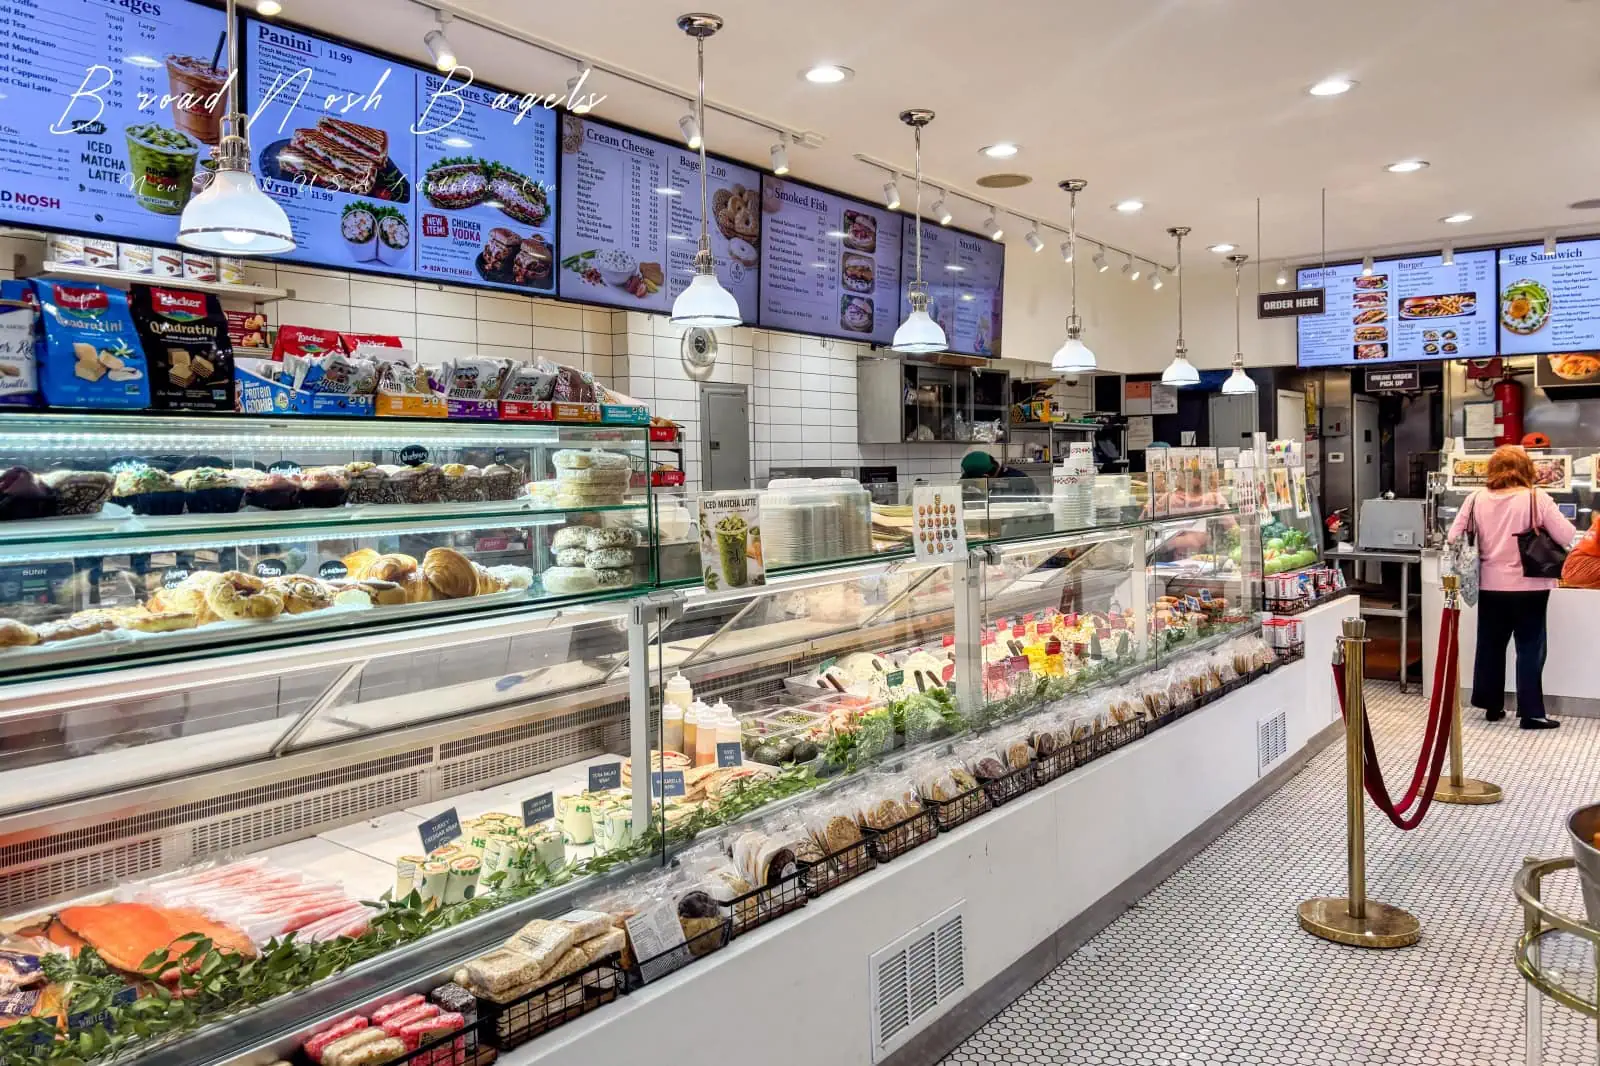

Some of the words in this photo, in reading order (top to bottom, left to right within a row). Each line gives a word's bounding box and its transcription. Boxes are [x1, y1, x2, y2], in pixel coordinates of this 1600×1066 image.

[12, 20, 26, 29] Tea
[12, 31, 57, 49] Americano
[258, 25, 312, 52] Panini
[328, 49, 353, 64] 11.99
[12, 42, 39, 56] Mocha
[11, 55, 32, 66] Latte
[11, 66, 58, 83] Cappuccino
[11, 77, 30, 89] Chai
[32, 82, 52, 93] Latte
[425, 76, 480, 102] Signature
[87, 140, 112, 154] ICED
[586, 128, 620, 148] Cream
[621, 138, 656, 158] Cheese
[81, 153, 126, 171] MATCHA
[679, 155, 702, 171] Bage
[711, 165, 727, 178] 2.00
[88, 168, 121, 184] LATTE
[259, 178, 298, 196] Wrap
[15, 192, 60, 209] NOSH
[775, 187, 809, 207] Smoked
[810, 197, 828, 213] Fish
[427, 216, 444, 226] NEW
[451, 218, 481, 231] CHICKEN
[452, 227, 481, 241] VODKA
[1508, 253, 1529, 266] Egg
[1530, 247, 1583, 263] Sandwich
[1263, 299, 1294, 311] ORDER
[1295, 297, 1320, 309] HERE
[149, 320, 218, 338] Quadratini
[1379, 380, 1394, 388] PICK
[1392, 372, 1413, 380] ORDER
[703, 500, 716, 510] ICED
[717, 499, 740, 509] MATCHA
[741, 497, 757, 507] LATTE
[257, 563, 282, 576] Pecan
